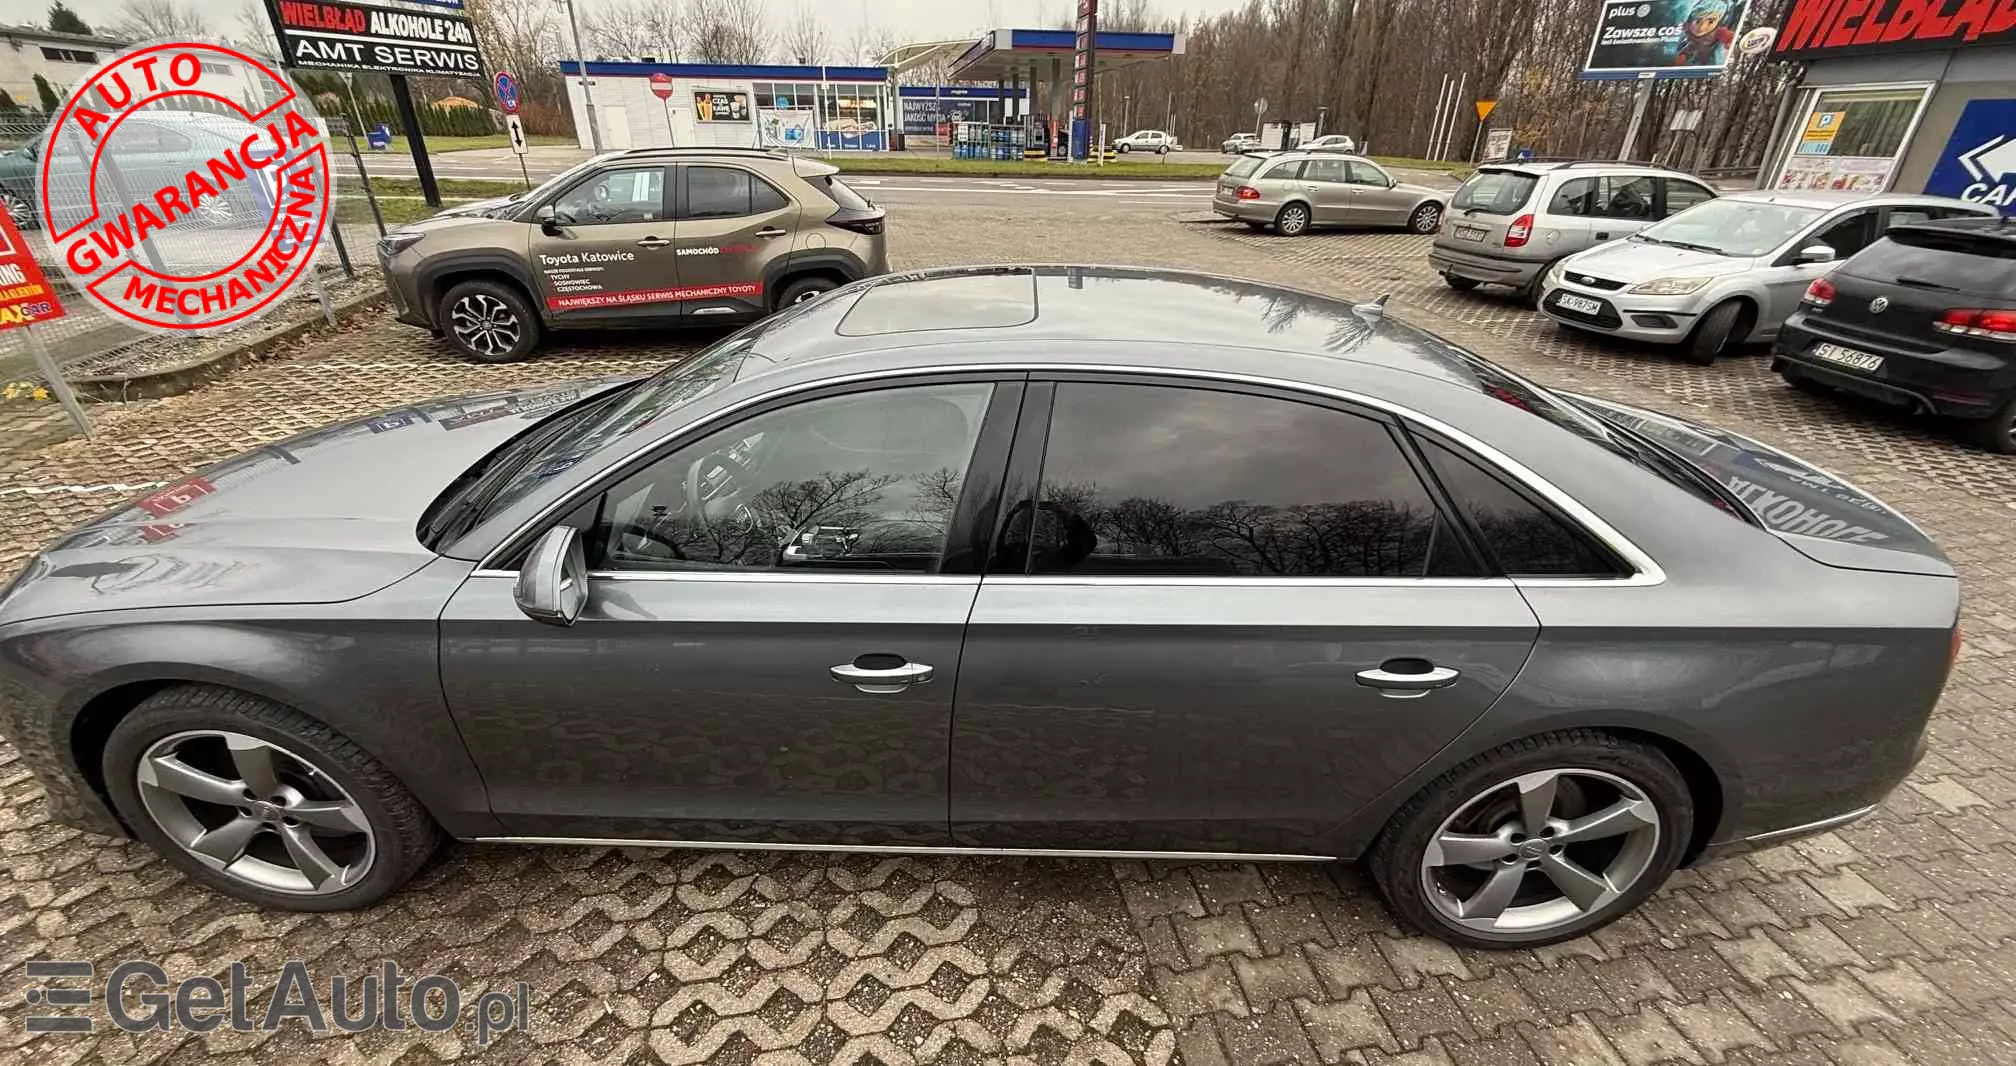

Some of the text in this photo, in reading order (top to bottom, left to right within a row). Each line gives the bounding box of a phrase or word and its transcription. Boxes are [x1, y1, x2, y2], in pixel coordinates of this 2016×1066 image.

[1609, 4, 1635, 19] plus
[280, 1, 473, 44] WIELBŁĄD ALKOHOLE 24h
[1603, 26, 1656, 39] Zawsze
[296, 39, 480, 71] AMT SERWIS
[298, 60, 361, 69] MECHANIKA
[539, 250, 635, 266] Toyota Katowice
[676, 246, 720, 256] SAMOCHÓD
[558, 296, 605, 306] NAJWIĘKSZY
[618, 293, 646, 304] ŚLĄSKU
[646, 291, 674, 301] SERWIS
[674, 287, 727, 298] MECHANICZNY
[728, 284, 757, 293] TOYOTY
[1838, 348, 1878, 369] 56876
